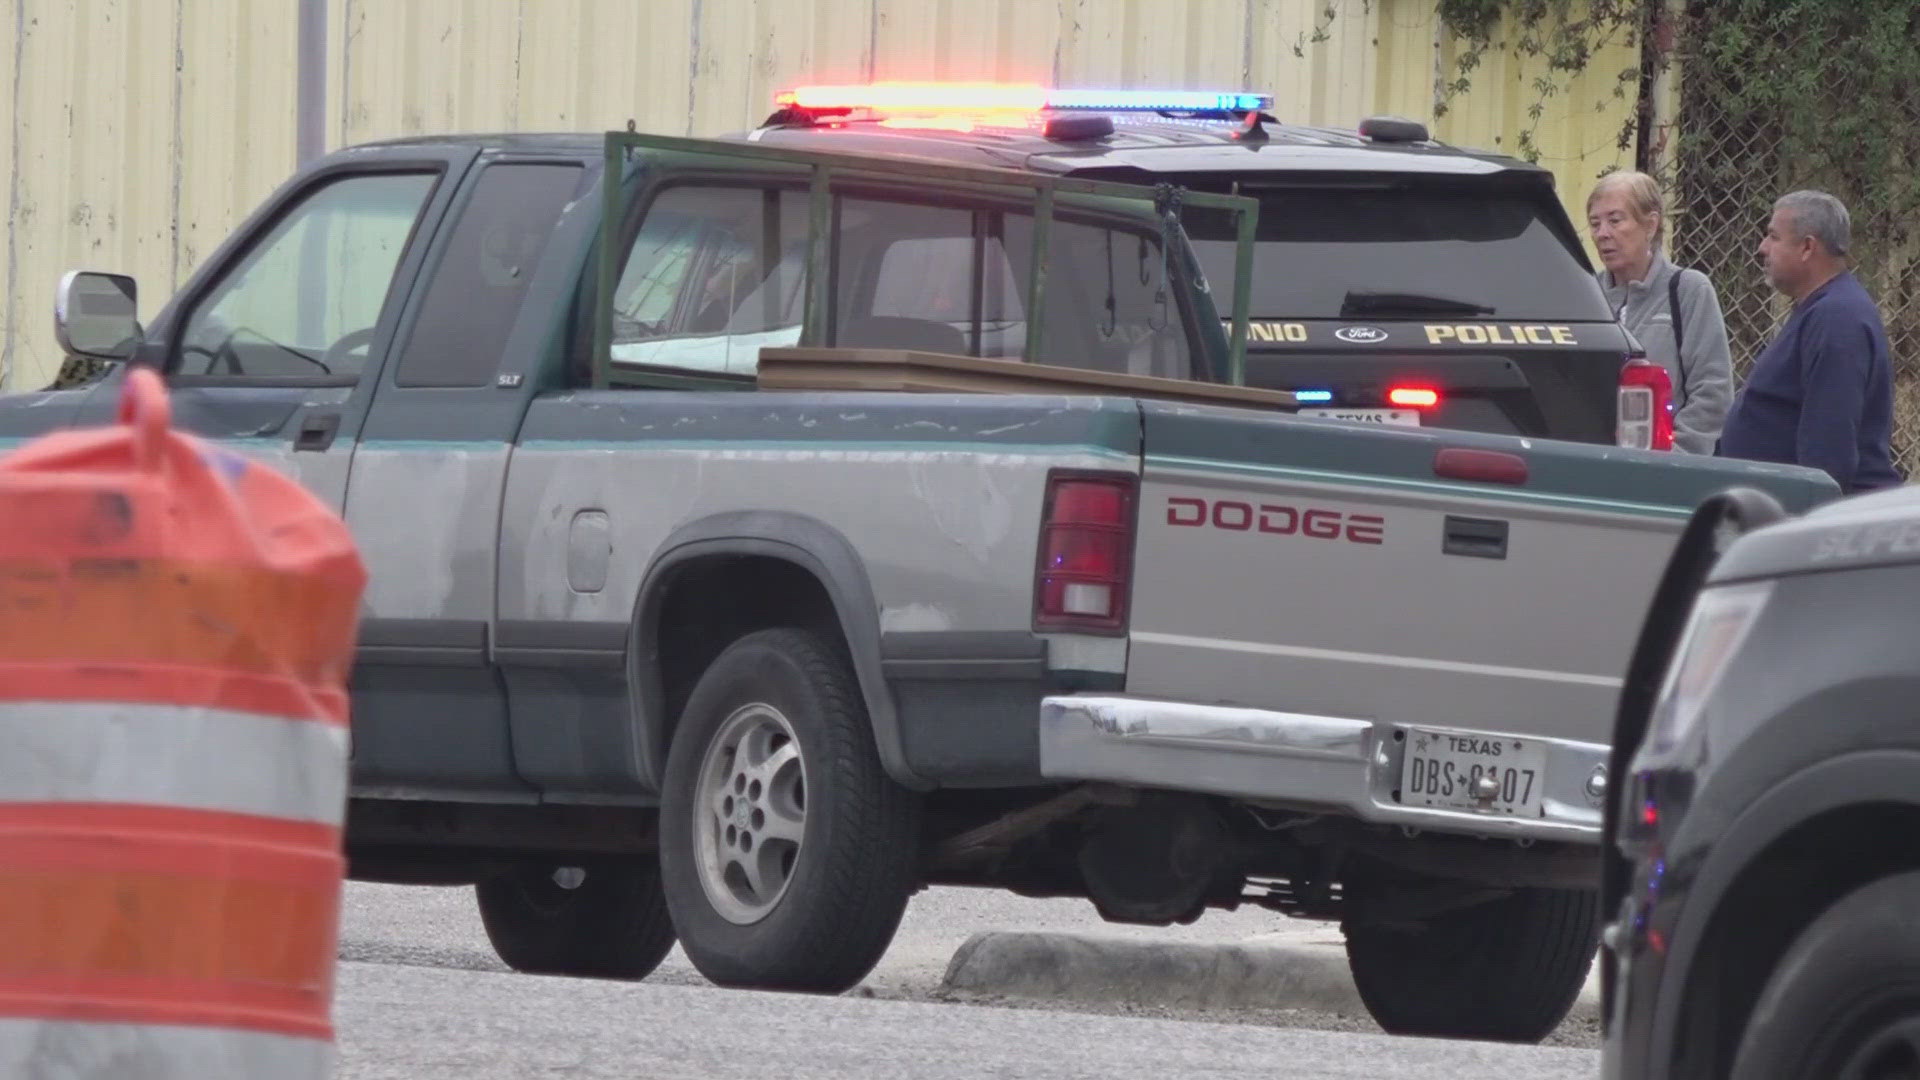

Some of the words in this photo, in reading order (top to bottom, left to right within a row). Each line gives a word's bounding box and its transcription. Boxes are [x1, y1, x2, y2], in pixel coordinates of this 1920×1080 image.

[1424, 325, 1578, 345] POLICE
[499, 374, 520, 386] SLT
[1167, 497, 1384, 545] DODGE
[1449, 737, 1502, 756] TEXAS
[1411, 757, 1455, 796] DBS
